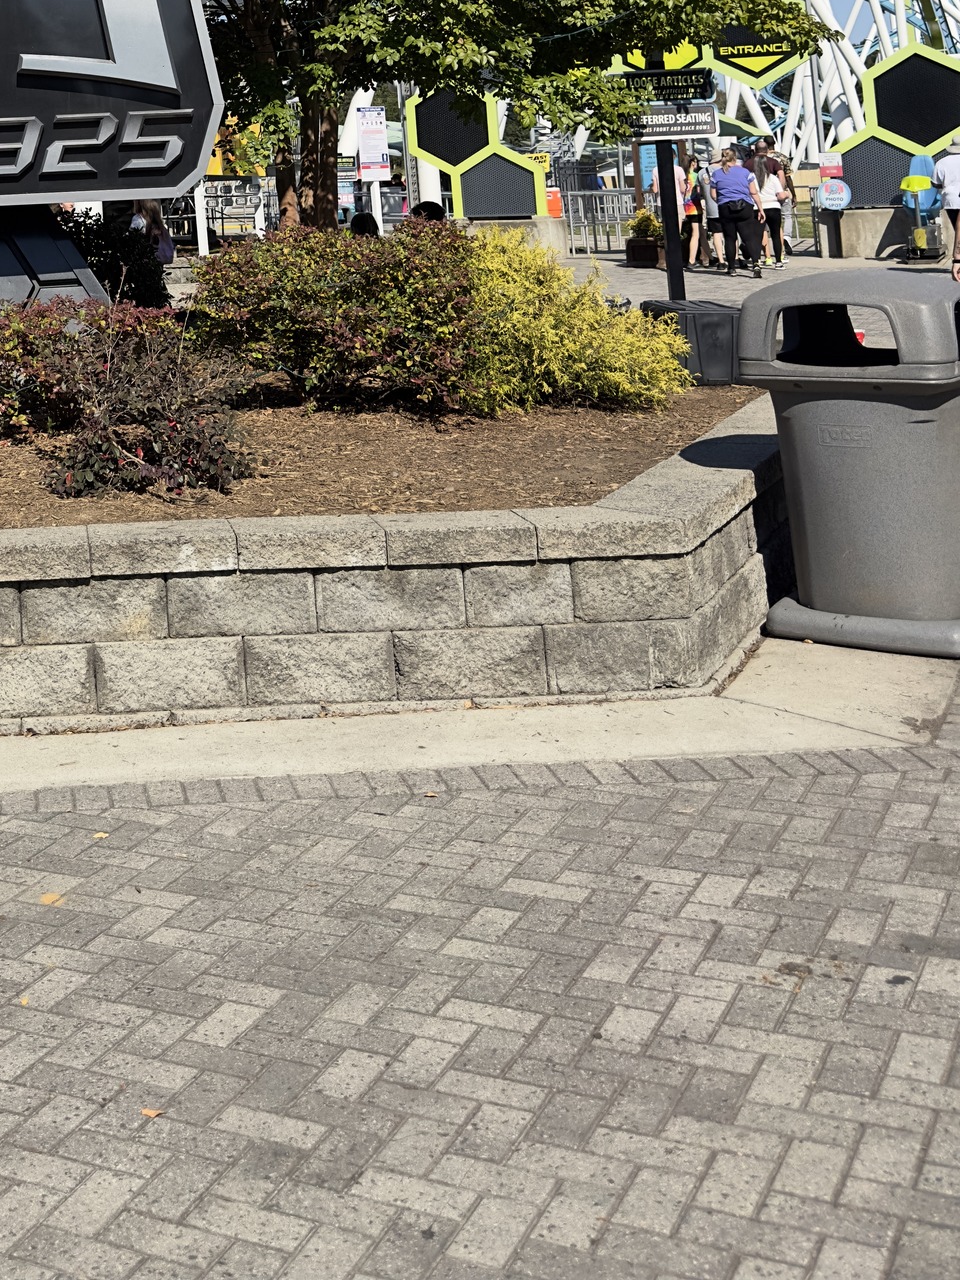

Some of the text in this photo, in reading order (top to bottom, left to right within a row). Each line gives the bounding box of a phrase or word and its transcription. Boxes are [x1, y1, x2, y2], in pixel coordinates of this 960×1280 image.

[720, 43, 791, 55] ENTRANCE
[629, 76, 659, 88] LOOSE
[660, 74, 704, 87] ARTICLES
[627, 114, 675, 126] PREFERRED
[676, 112, 712, 124] SEATING
